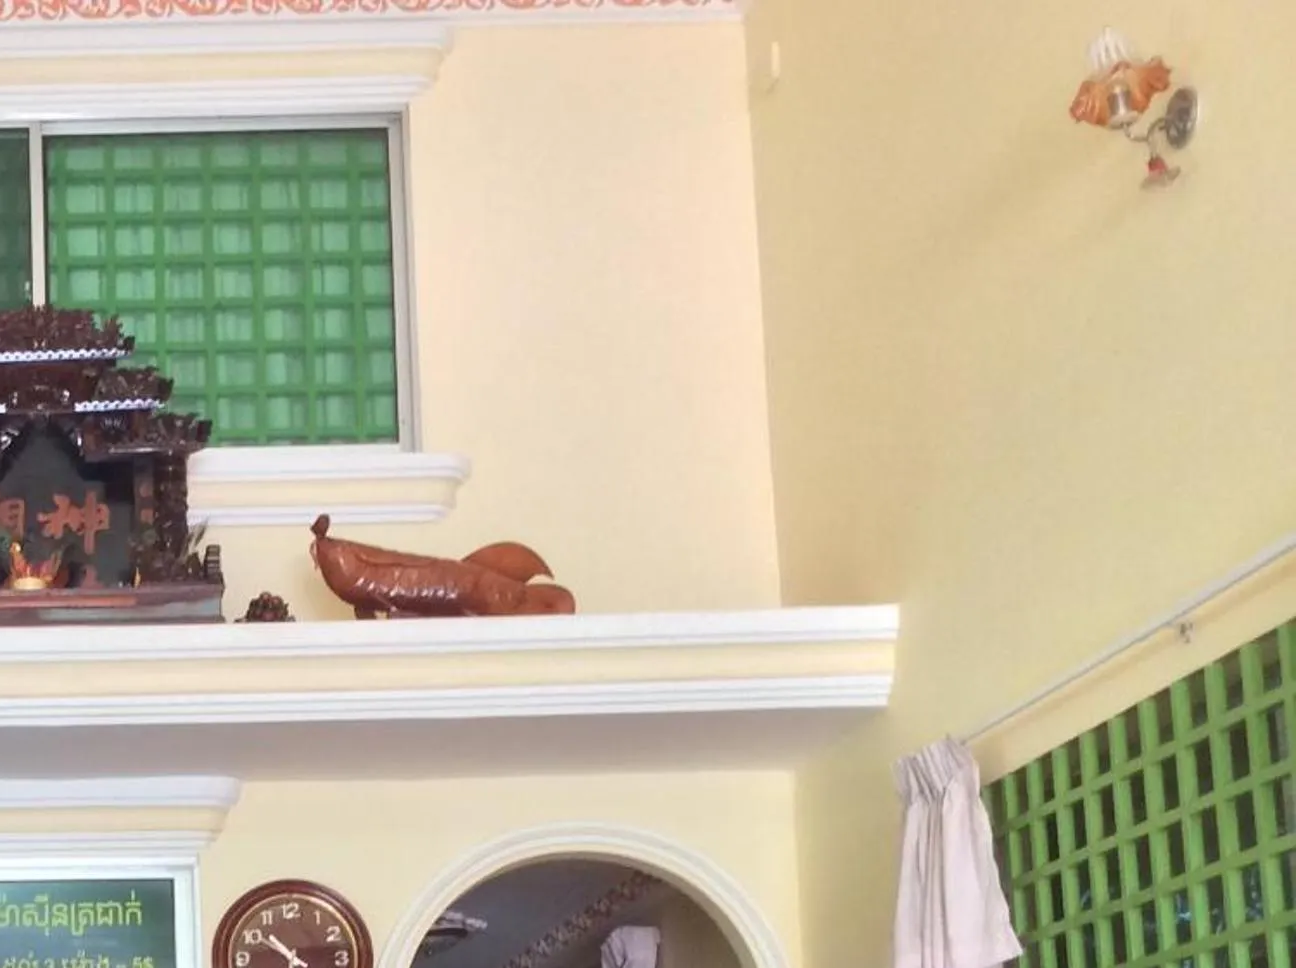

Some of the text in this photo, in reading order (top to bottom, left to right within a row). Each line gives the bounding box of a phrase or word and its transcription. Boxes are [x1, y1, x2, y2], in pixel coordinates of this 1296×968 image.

[260, 911, 273, 925] 11
[281, 903, 301, 919] 12
[314, 911, 321, 925] 1
[243, 929, 262, 944] 10
[326, 926, 341, 942] 2
[236, 952, 250, 967] 9
[335, 951, 349, 966] 3
